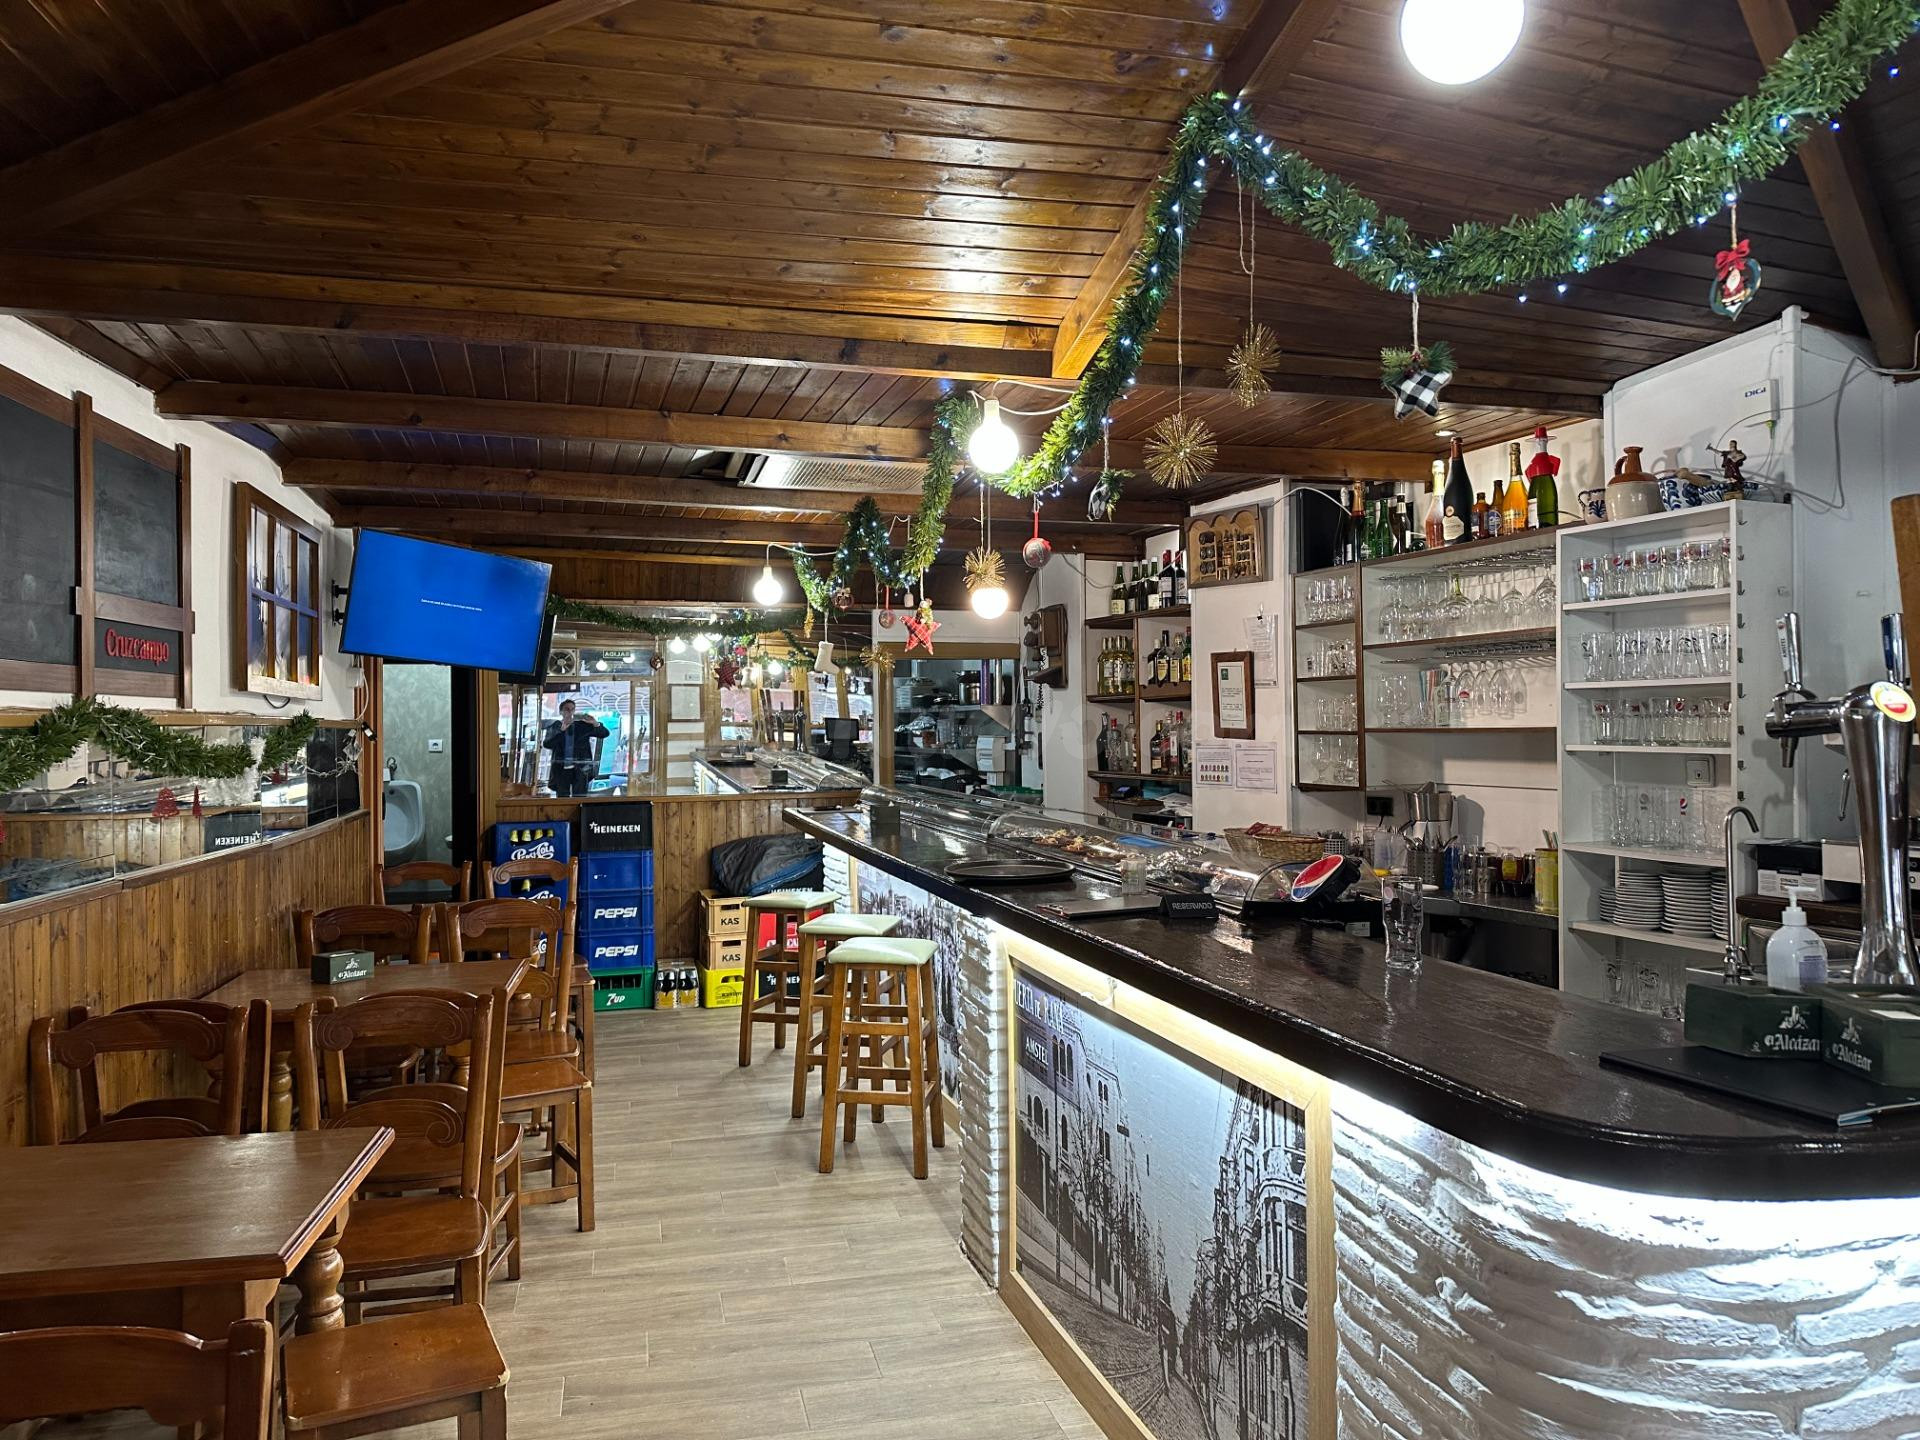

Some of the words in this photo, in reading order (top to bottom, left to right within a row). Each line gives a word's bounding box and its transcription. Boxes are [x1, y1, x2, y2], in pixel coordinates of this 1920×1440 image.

[1744, 387, 1766, 398] DIGI
[105, 627, 170, 667] Cruzcampo
[593, 824, 641, 834] HEINEKEN
[1171, 902, 1213, 910] RESERVADO
[594, 907, 638, 919] PEPSI
[720, 917, 740, 926] KAS
[594, 945, 639, 957] PEPSI
[722, 953, 741, 962] KAS
[607, 992, 625, 1006] 7UP
[1025, 1035, 1049, 1067] AMSTEL
